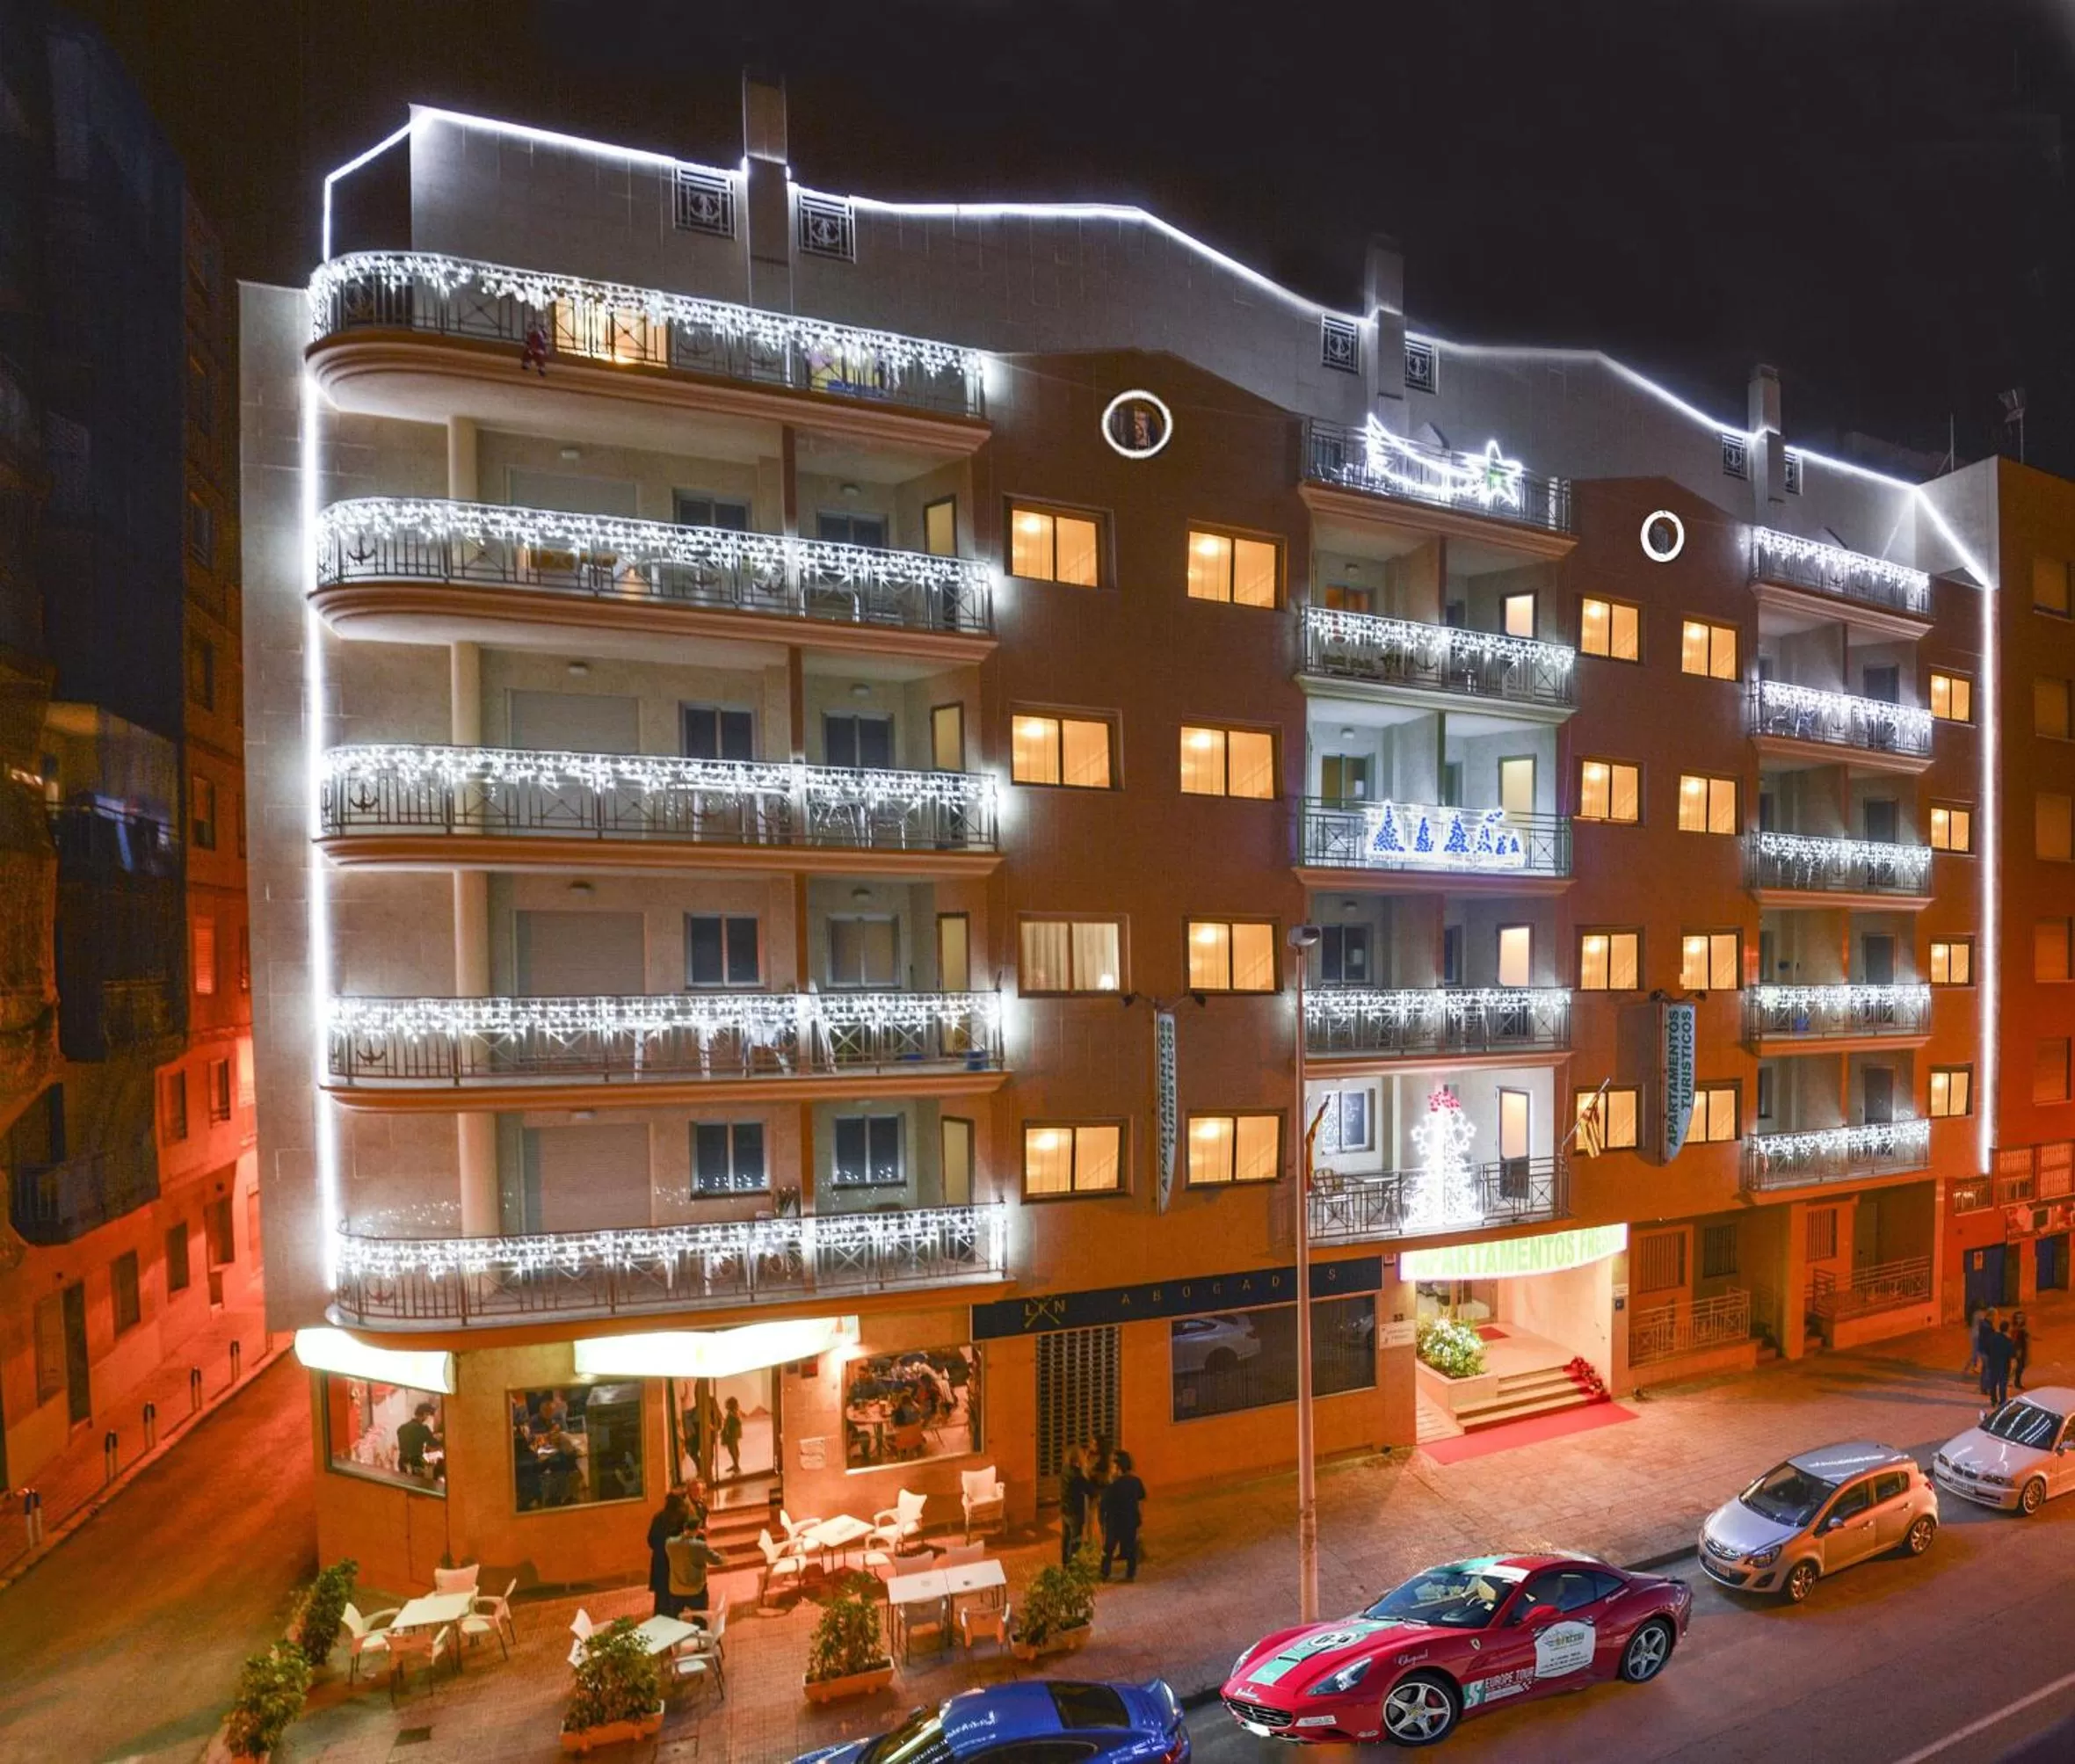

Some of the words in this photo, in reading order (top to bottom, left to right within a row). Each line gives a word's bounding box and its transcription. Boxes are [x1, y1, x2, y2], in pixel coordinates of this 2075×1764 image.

[1159, 1020, 1168, 1193] APARTAMENTOS
[1669, 1010, 1680, 1147] APARTAMENTOS
[1681, 1011, 1693, 1111] TURISTICOS
[1121, 1267, 1336, 1305] ABOGADS
